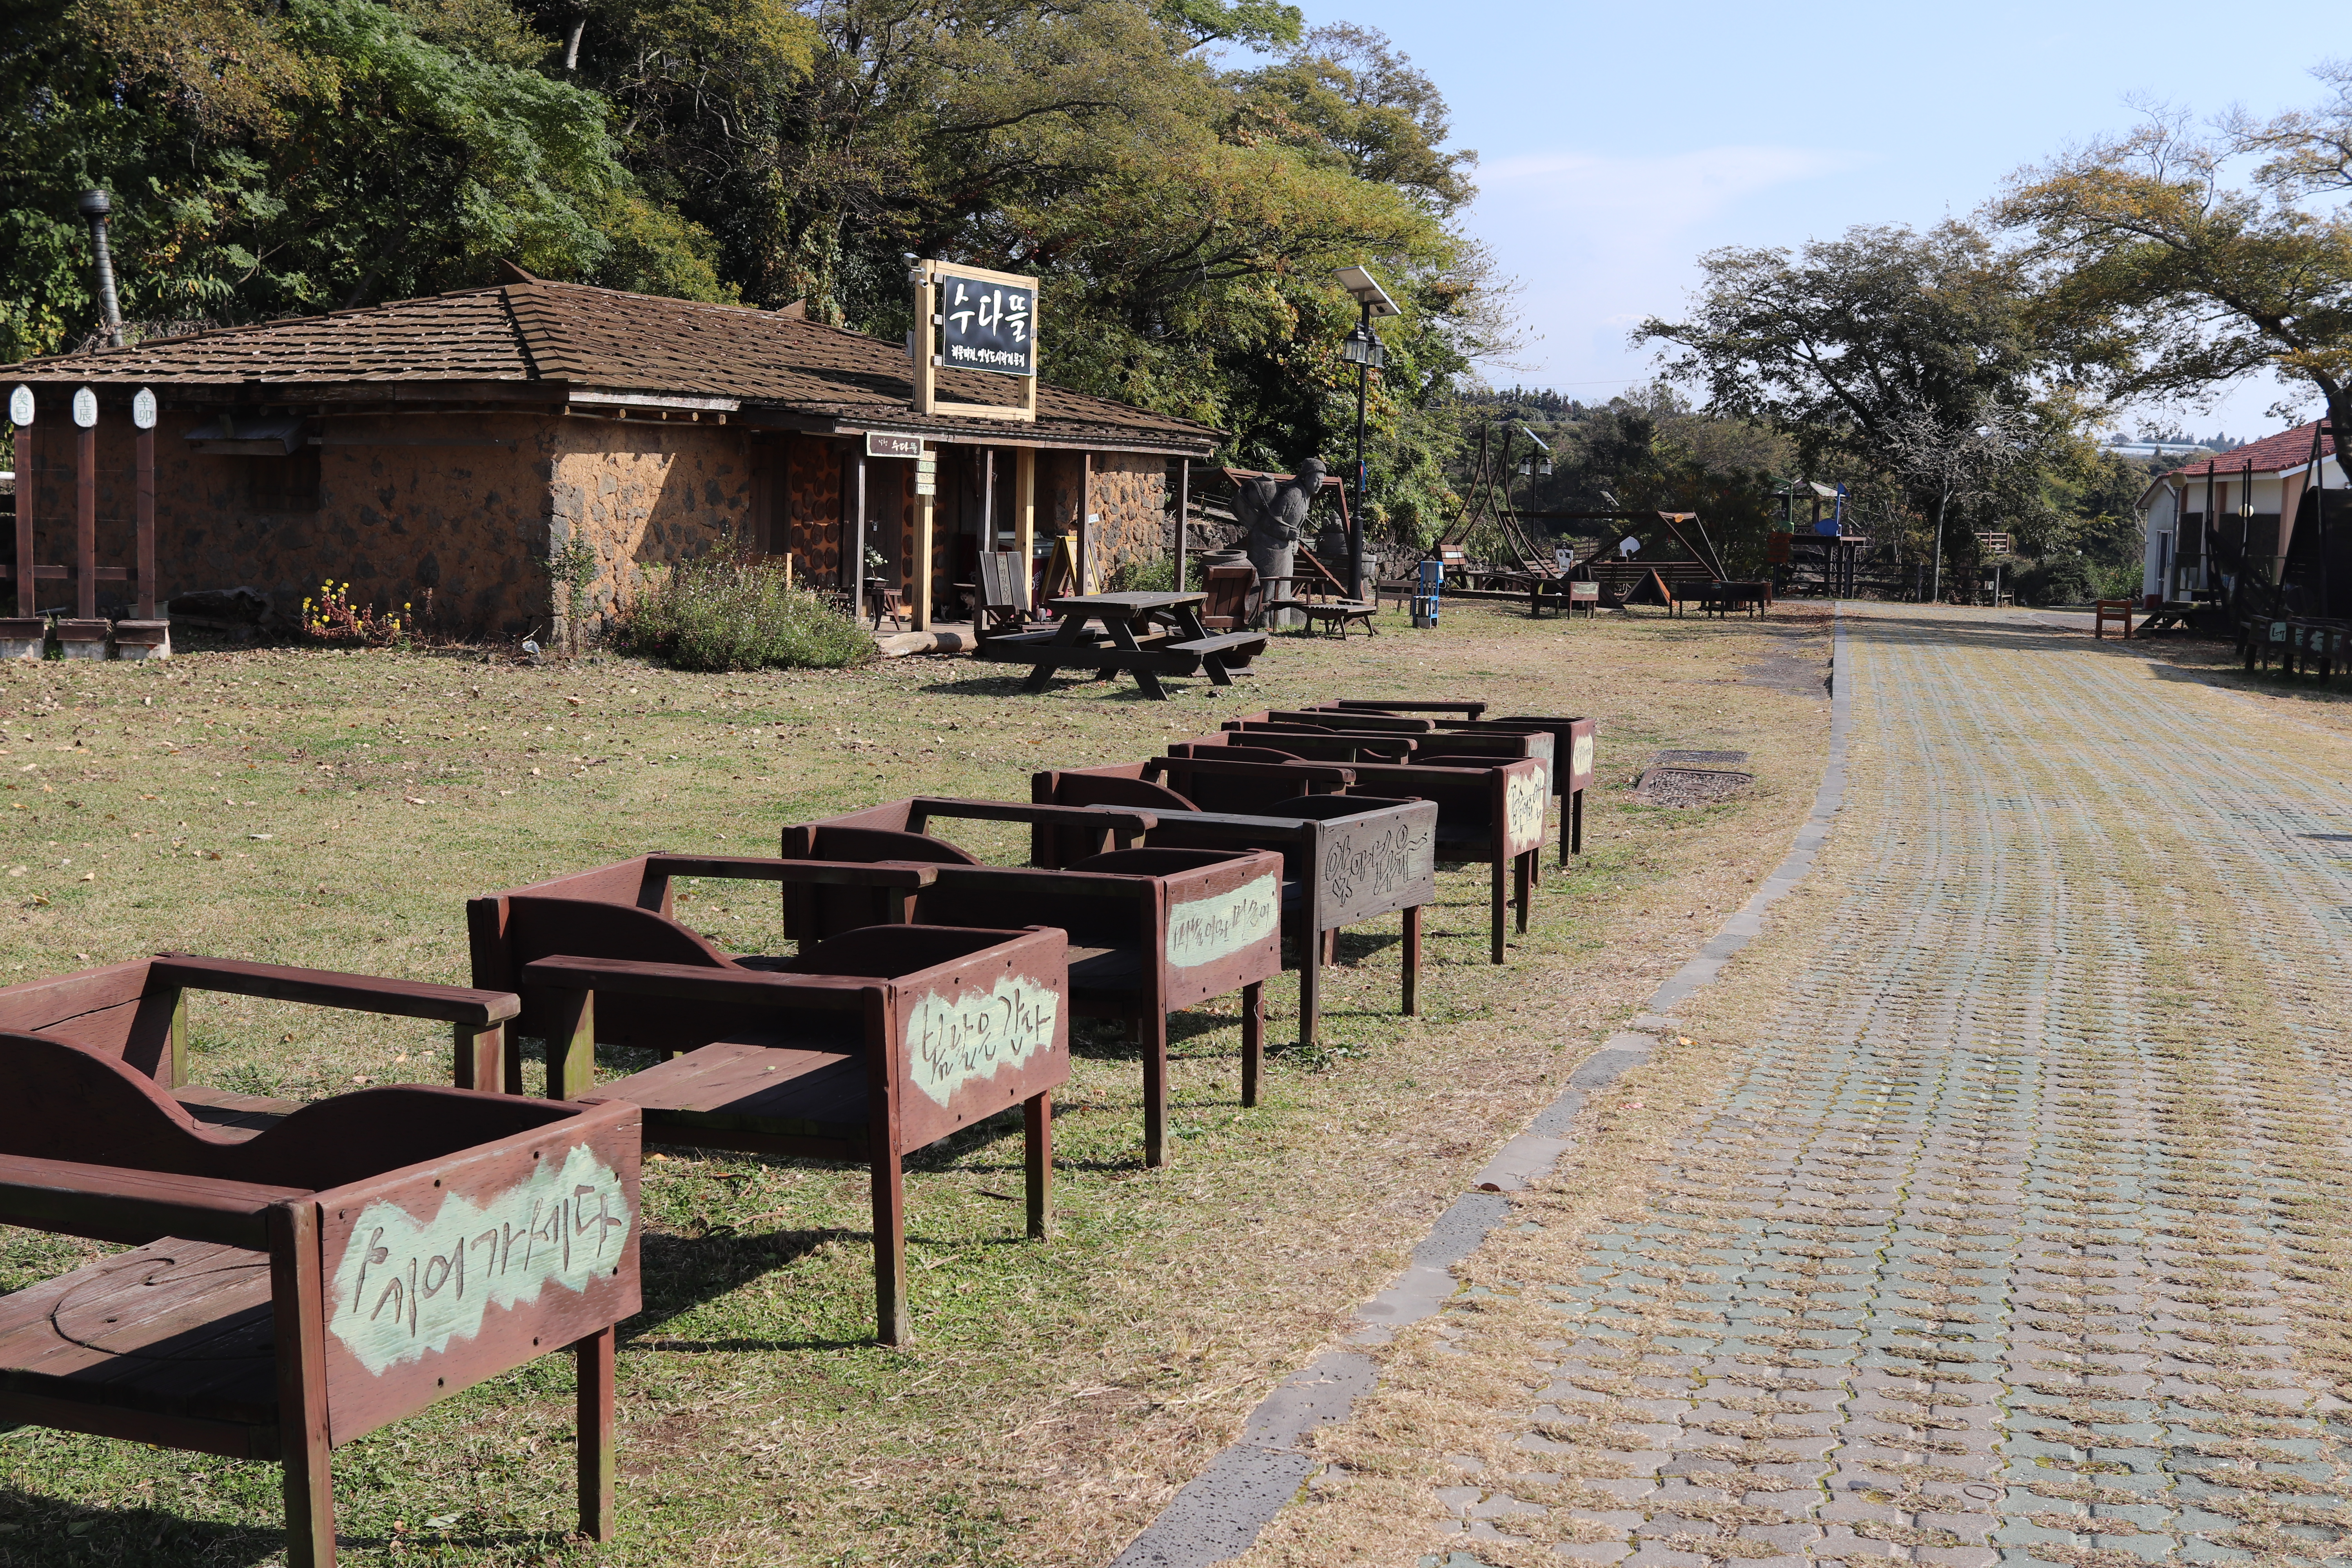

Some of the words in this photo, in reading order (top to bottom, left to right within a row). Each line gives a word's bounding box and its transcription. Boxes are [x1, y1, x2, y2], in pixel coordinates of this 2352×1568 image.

[949, 283, 1029, 343] 수다뜰
[78, 394, 92, 421] 壬辰
[138, 396, 153, 423] 辛卯
[891, 440, 918, 454] 수다뜰
